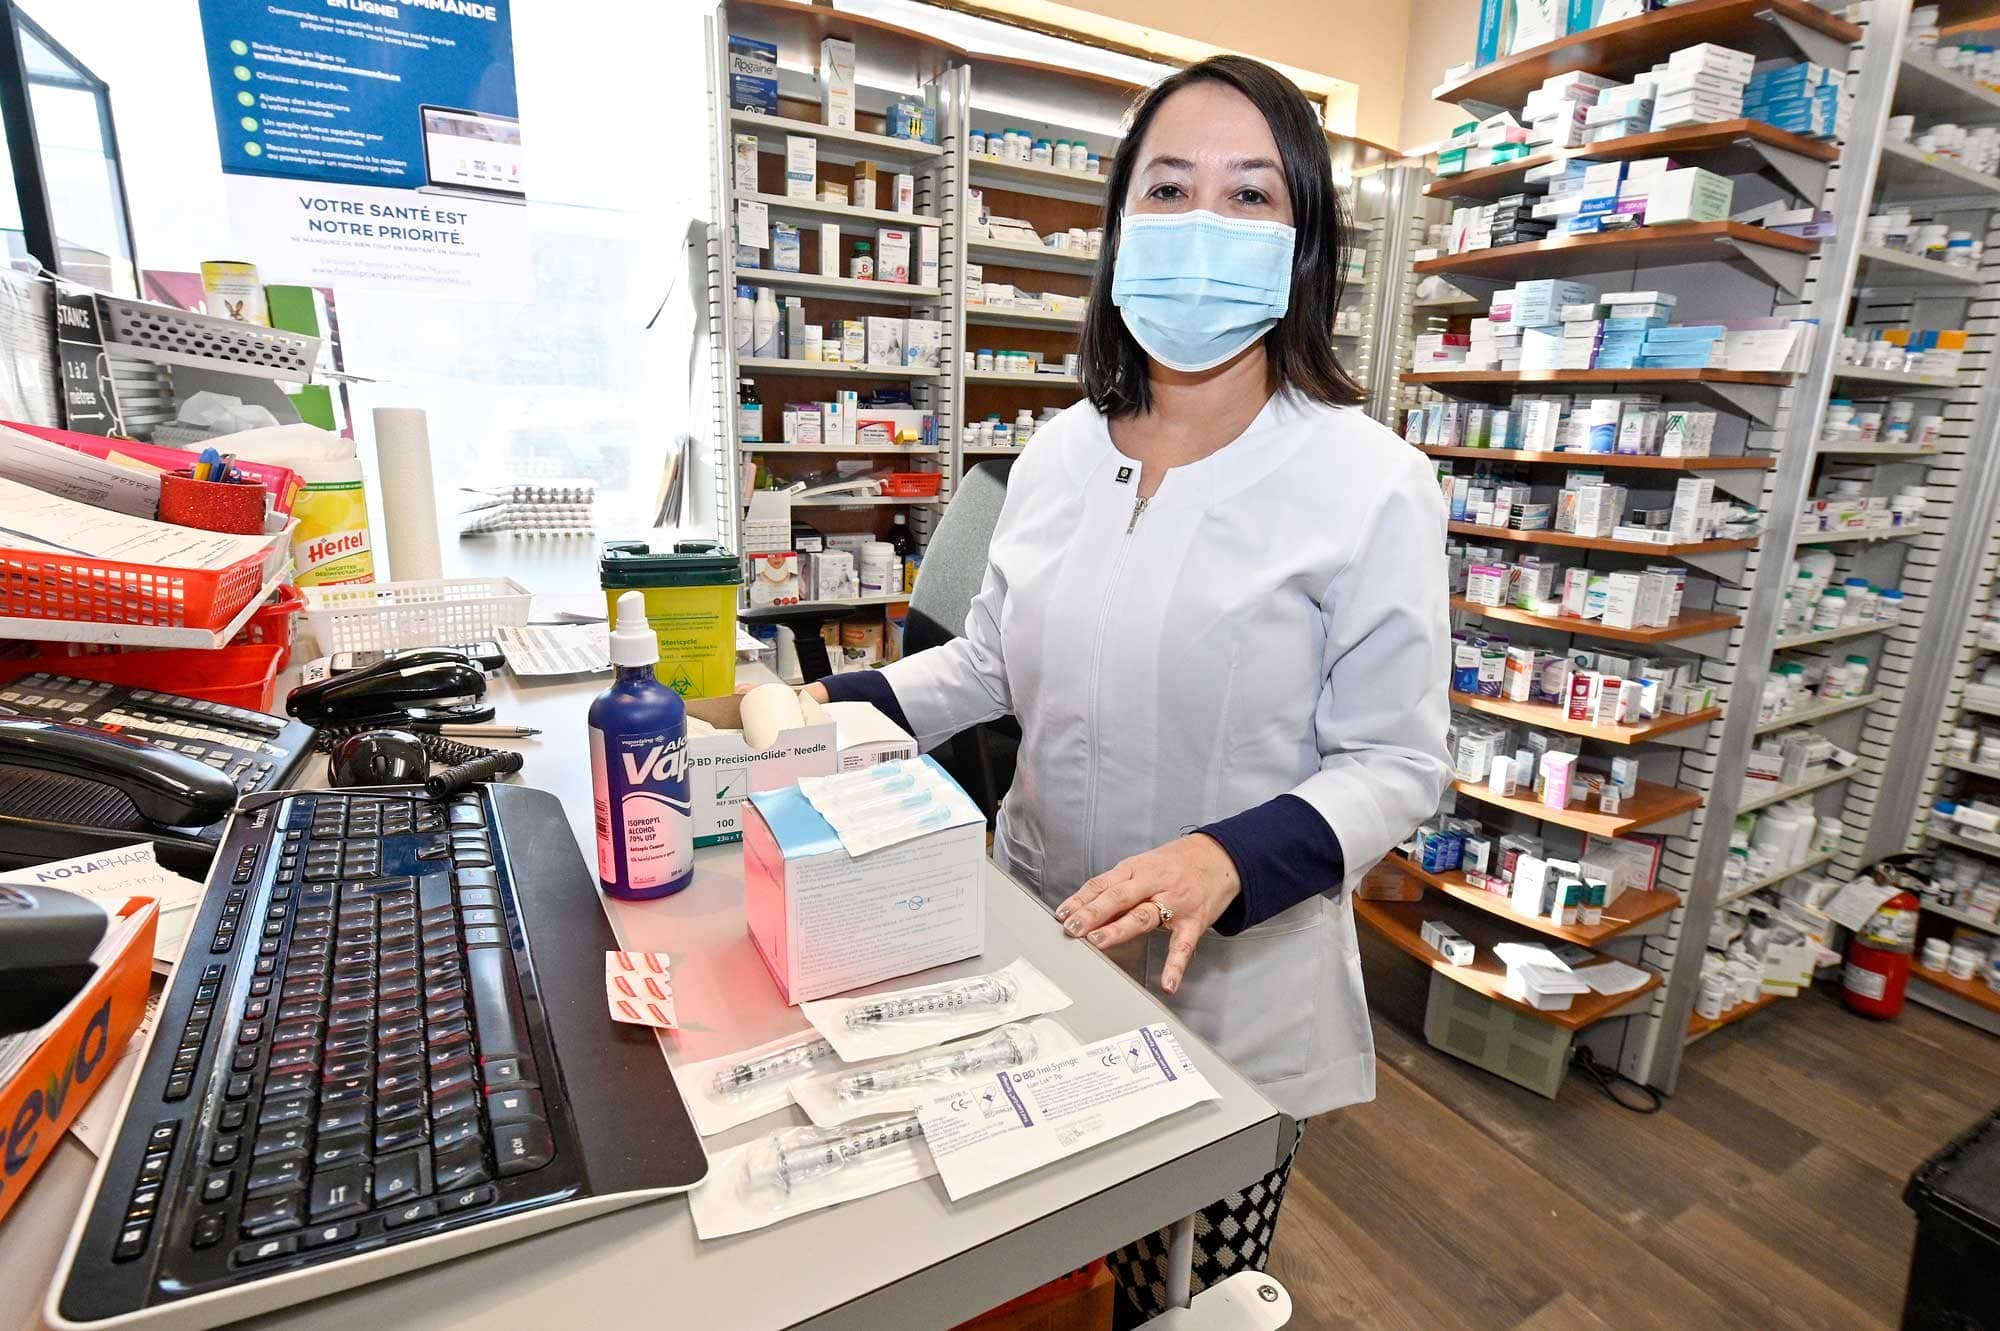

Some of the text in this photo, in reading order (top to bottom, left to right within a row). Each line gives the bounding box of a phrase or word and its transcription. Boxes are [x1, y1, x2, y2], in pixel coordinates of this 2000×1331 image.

[734, 56, 773, 76] Rogaine
[299, 196, 468, 225] VOTRE SANTÉ EST
[308, 218, 465, 246] NOTRE PRIORITÉ.
[862, 264, 869, 273] B
[57, 304, 91, 329] STANCE
[67, 361, 89, 380] 1 à 2
[69, 386, 97, 406] mètres
[308, 531, 363, 563] Hertel
[697, 757, 712, 768] BD
[794, 742, 827, 757] Needle
[627, 816, 661, 827] ISOPROPYL
[628, 824, 655, 835] ALCOHOL
[716, 818, 735, 829] 100
[629, 833, 657, 843] 70% USP
[1022, 1069, 1036, 1081] BD
[1050, 1056, 1079, 1073] Syringe
[0, 995, 113, 1196] eva
